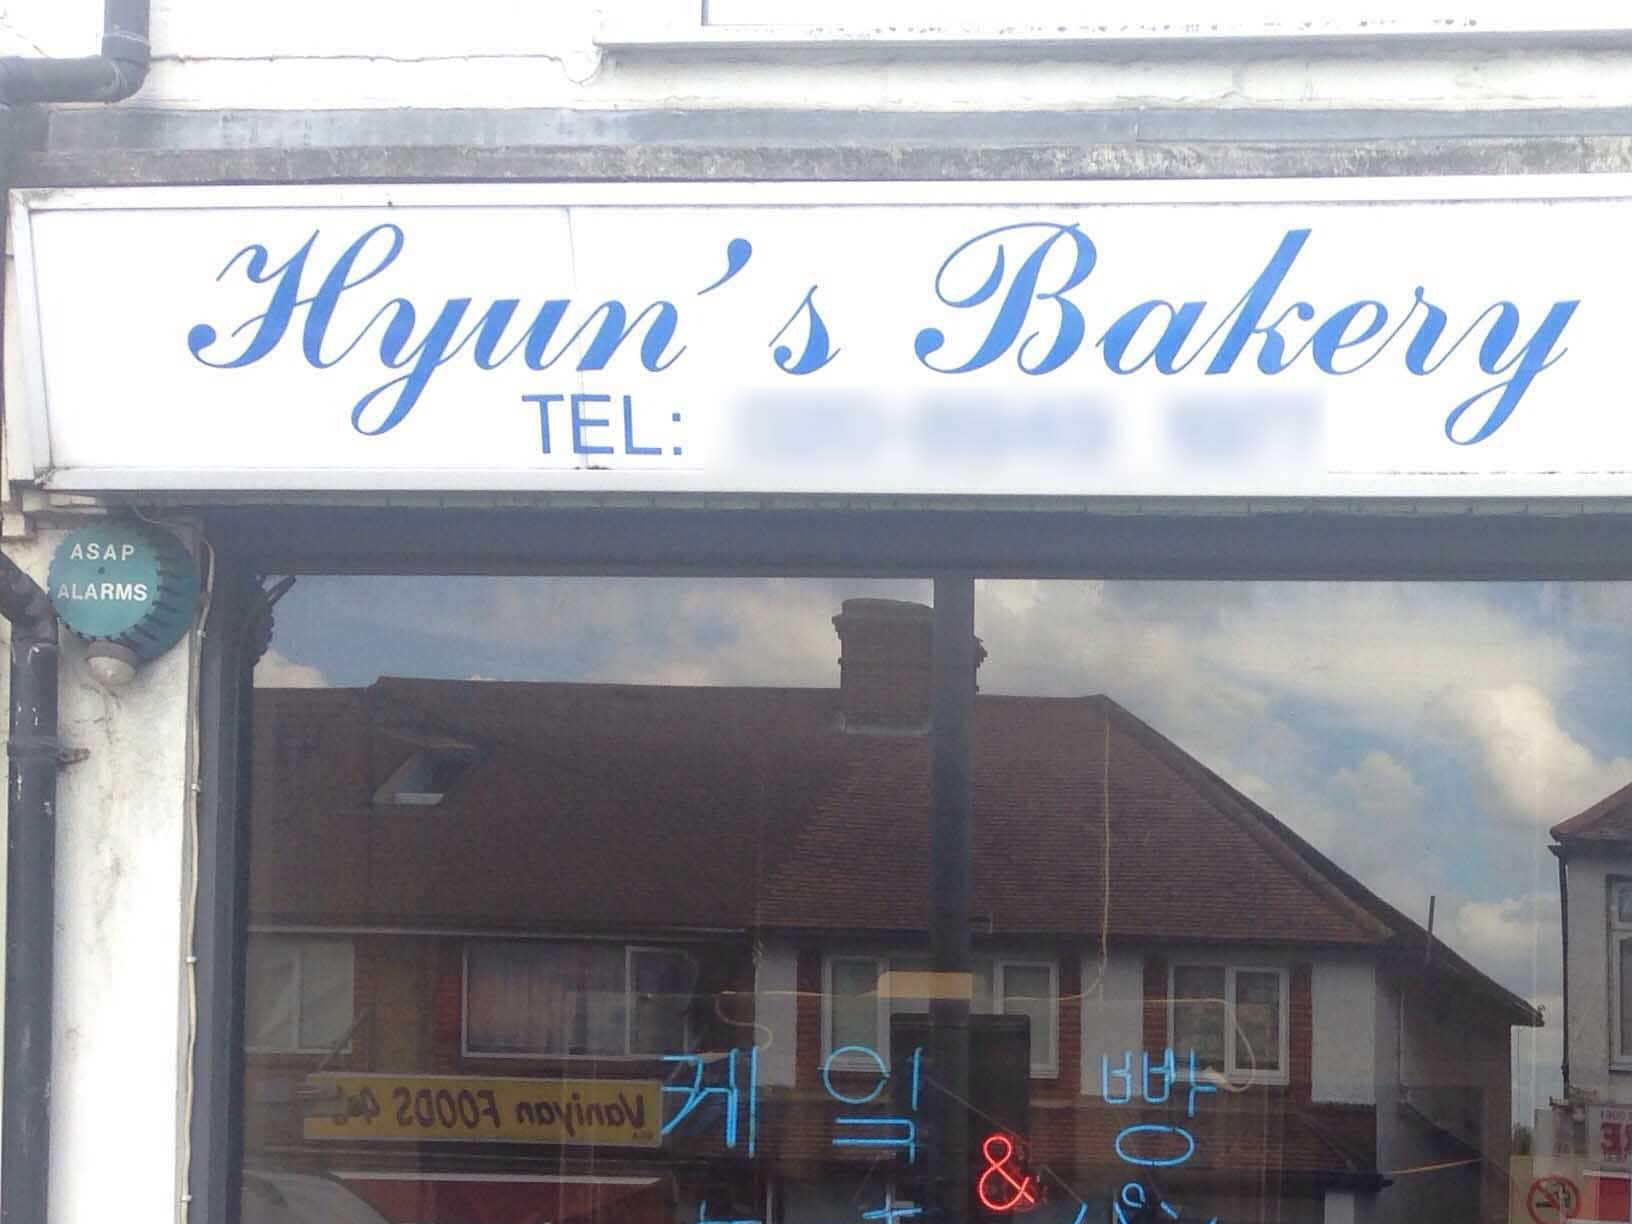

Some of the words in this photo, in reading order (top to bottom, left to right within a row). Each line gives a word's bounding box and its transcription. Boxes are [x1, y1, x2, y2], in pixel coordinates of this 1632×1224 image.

[188, 223, 842, 437] Hyun's
[914, 222, 1582, 446] Bakery
[521, 393, 684, 457] TEL:
[70, 541, 135, 562] ASAP
[57, 581, 149, 603] ALARMS
[1102, 1047, 1217, 1166] 빵
[977, 1133, 1035, 1211] &
